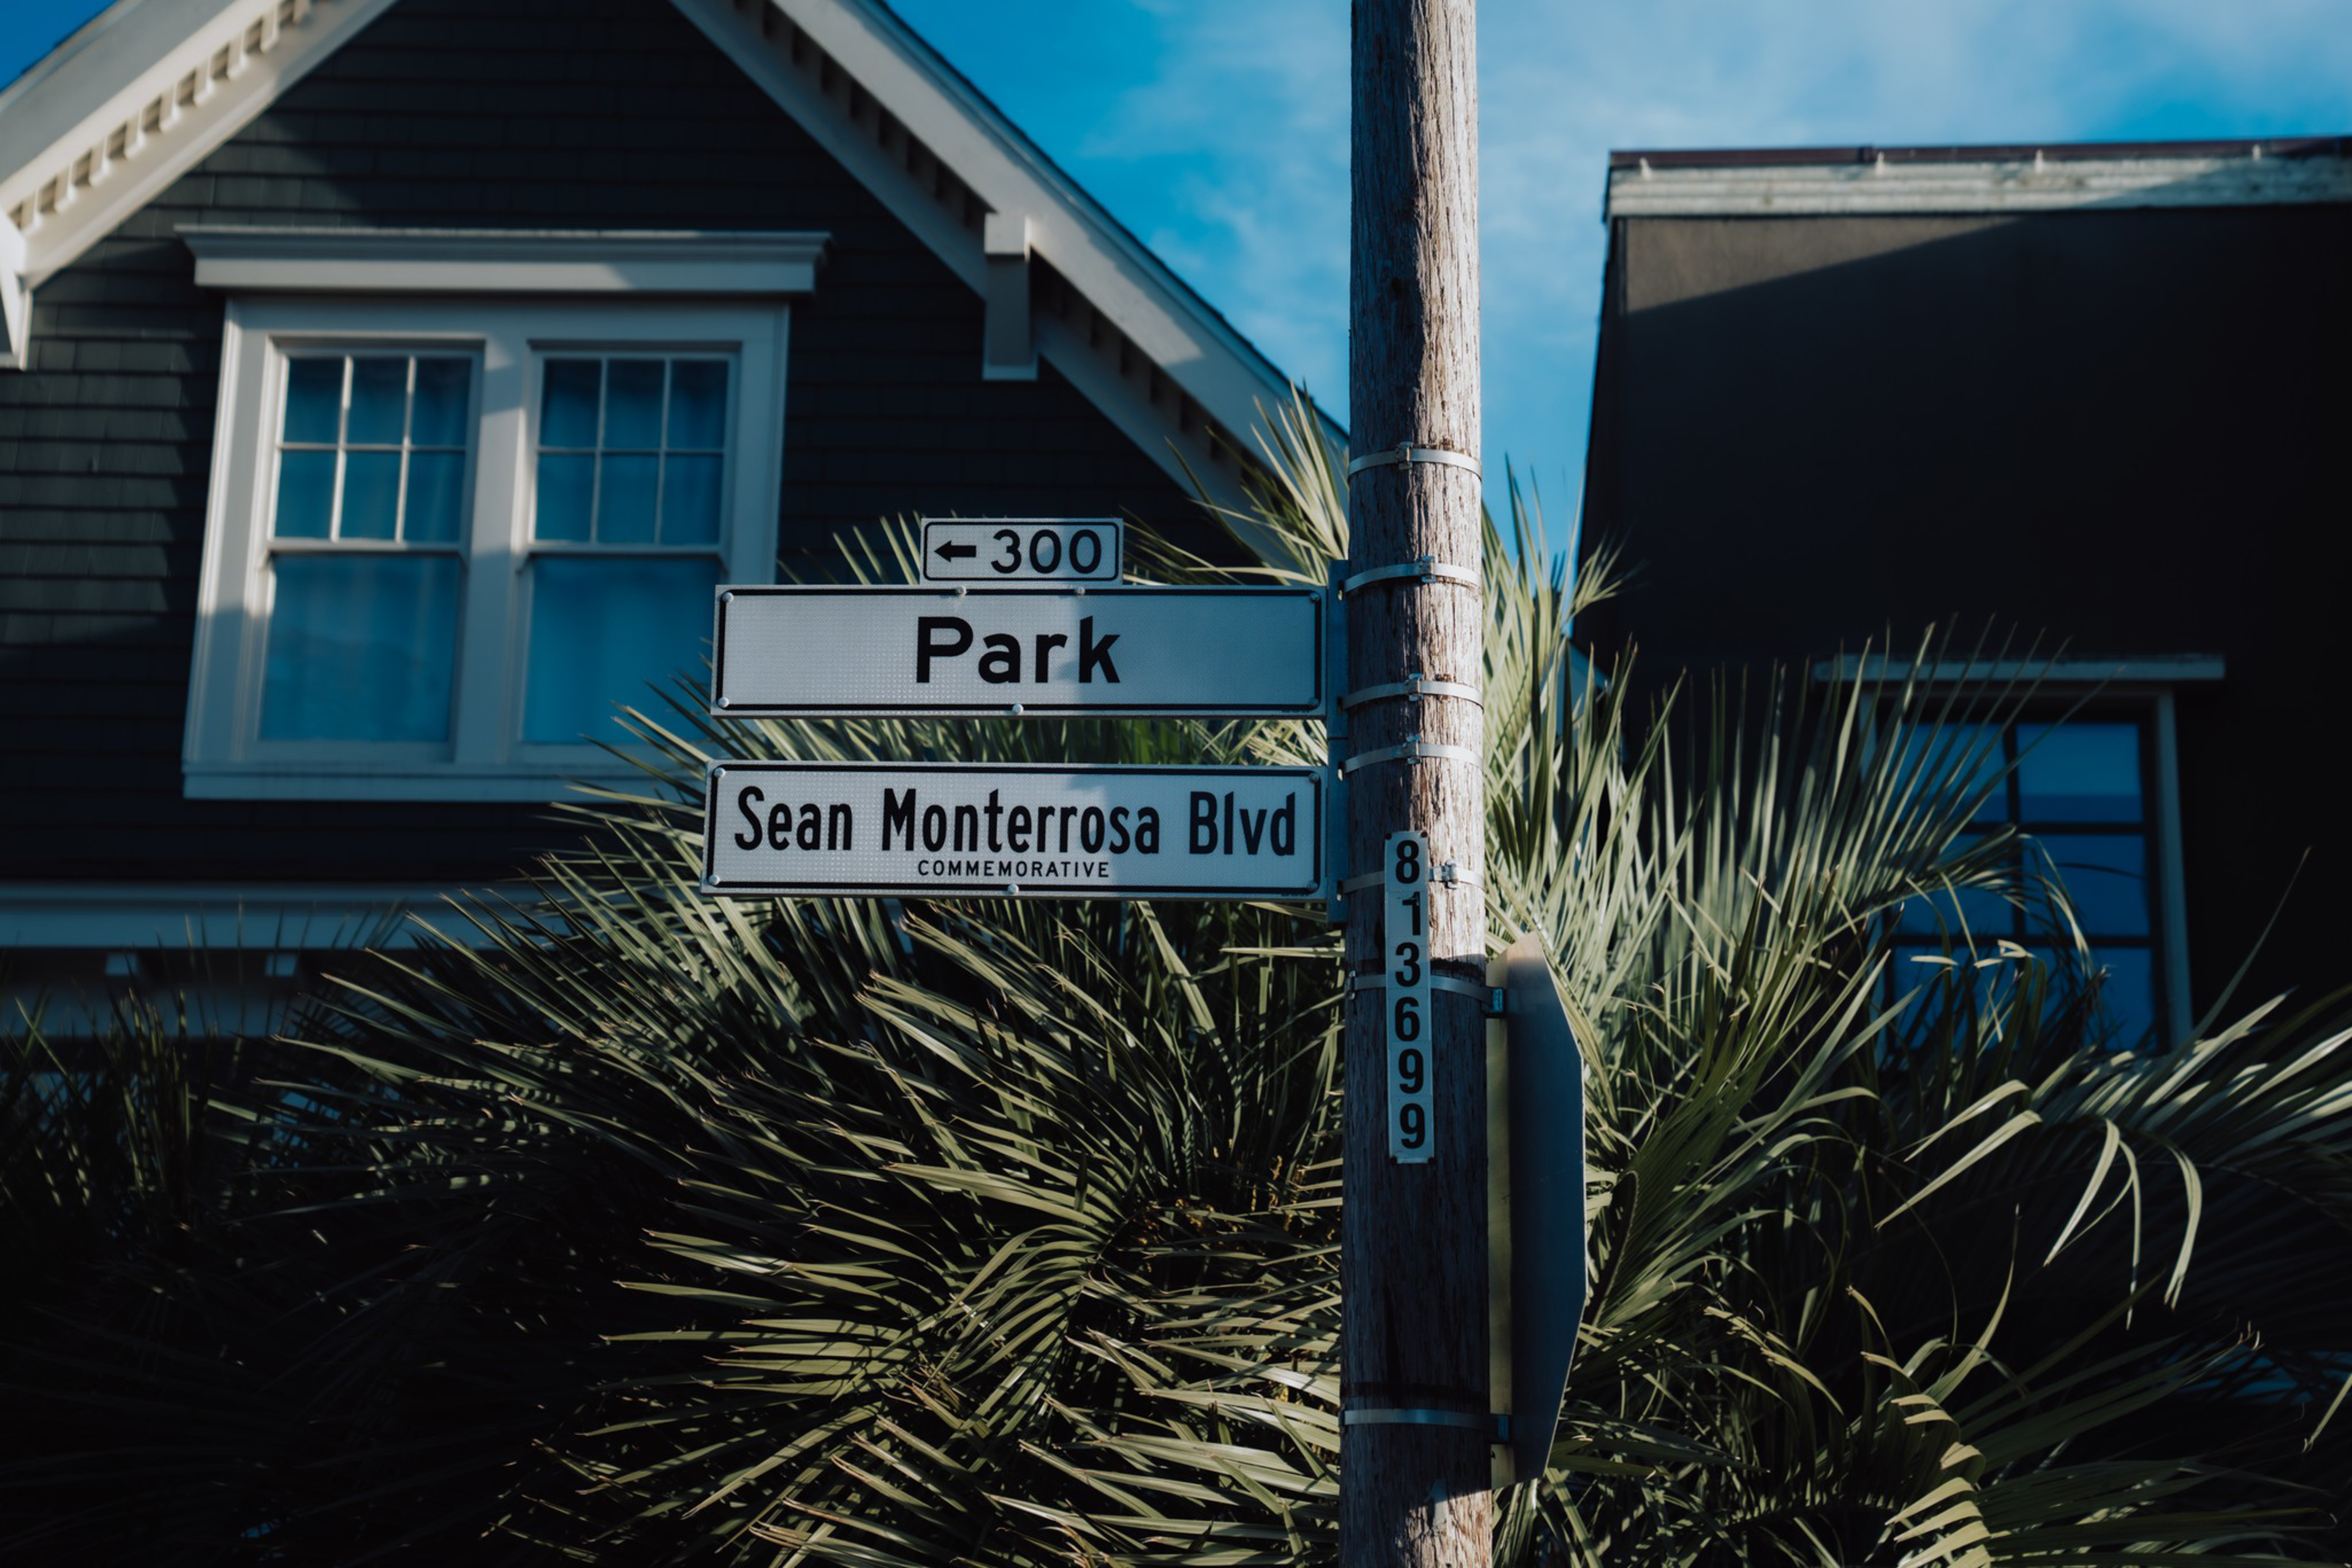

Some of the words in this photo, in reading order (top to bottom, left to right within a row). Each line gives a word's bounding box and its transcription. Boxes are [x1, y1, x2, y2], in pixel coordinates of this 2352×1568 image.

[991, 529, 1102, 575] 300
[916, 615, 1121, 684] Park
[735, 786, 853, 851] Sean
[882, 788, 1160, 855] Monterrosa
[1189, 791, 1296, 857] Blvd
[918, 859, 1110, 878] COMMEMORATIVE
[1394, 839, 1426, 1150] 813699
